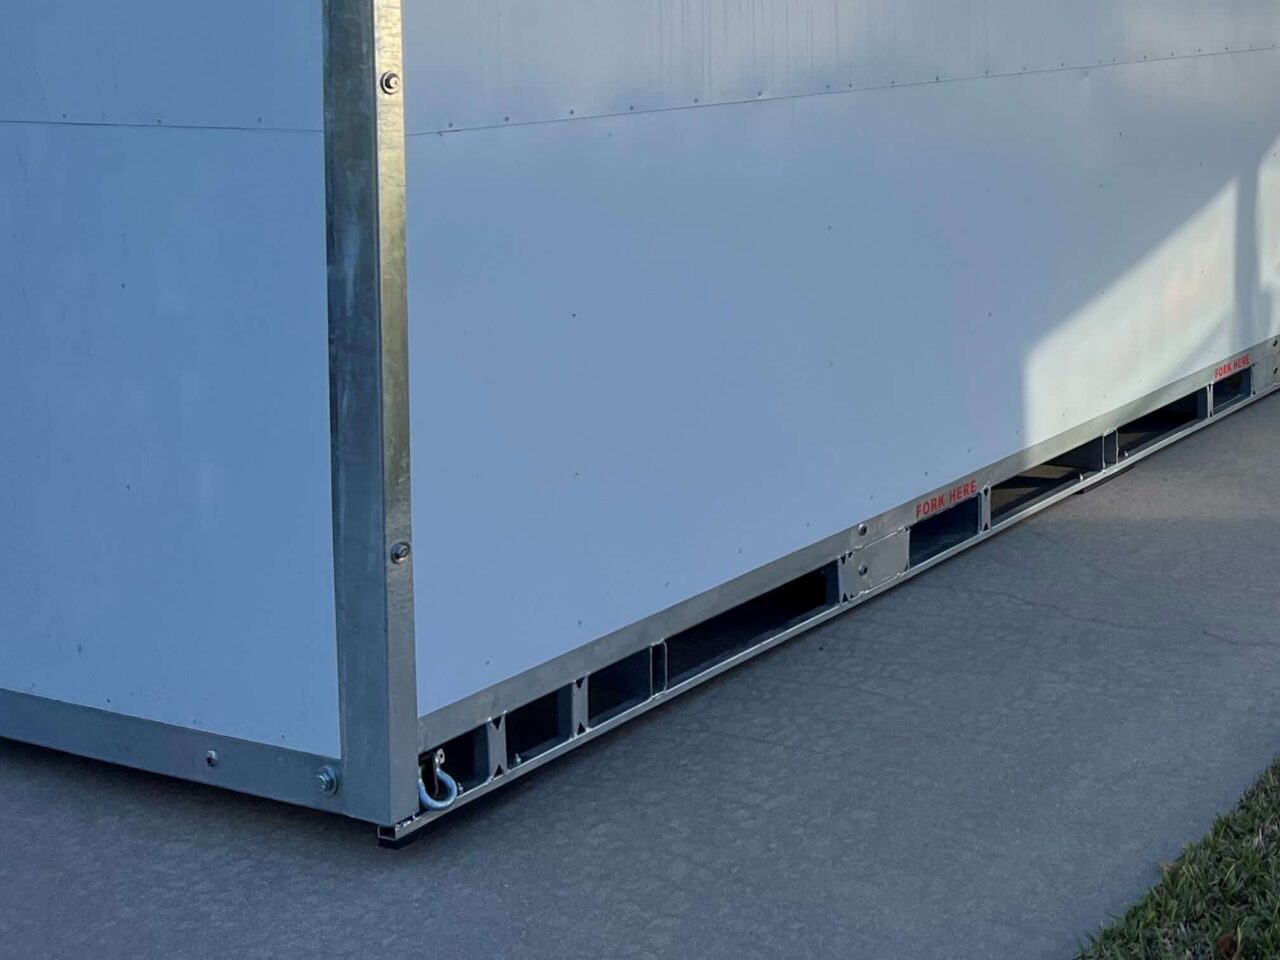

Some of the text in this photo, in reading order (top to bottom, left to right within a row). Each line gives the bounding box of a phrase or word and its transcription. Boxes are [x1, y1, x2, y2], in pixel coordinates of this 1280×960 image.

[1215, 352, 1249, 380] FORK HERE
[915, 479, 977, 518] FORK HERE
